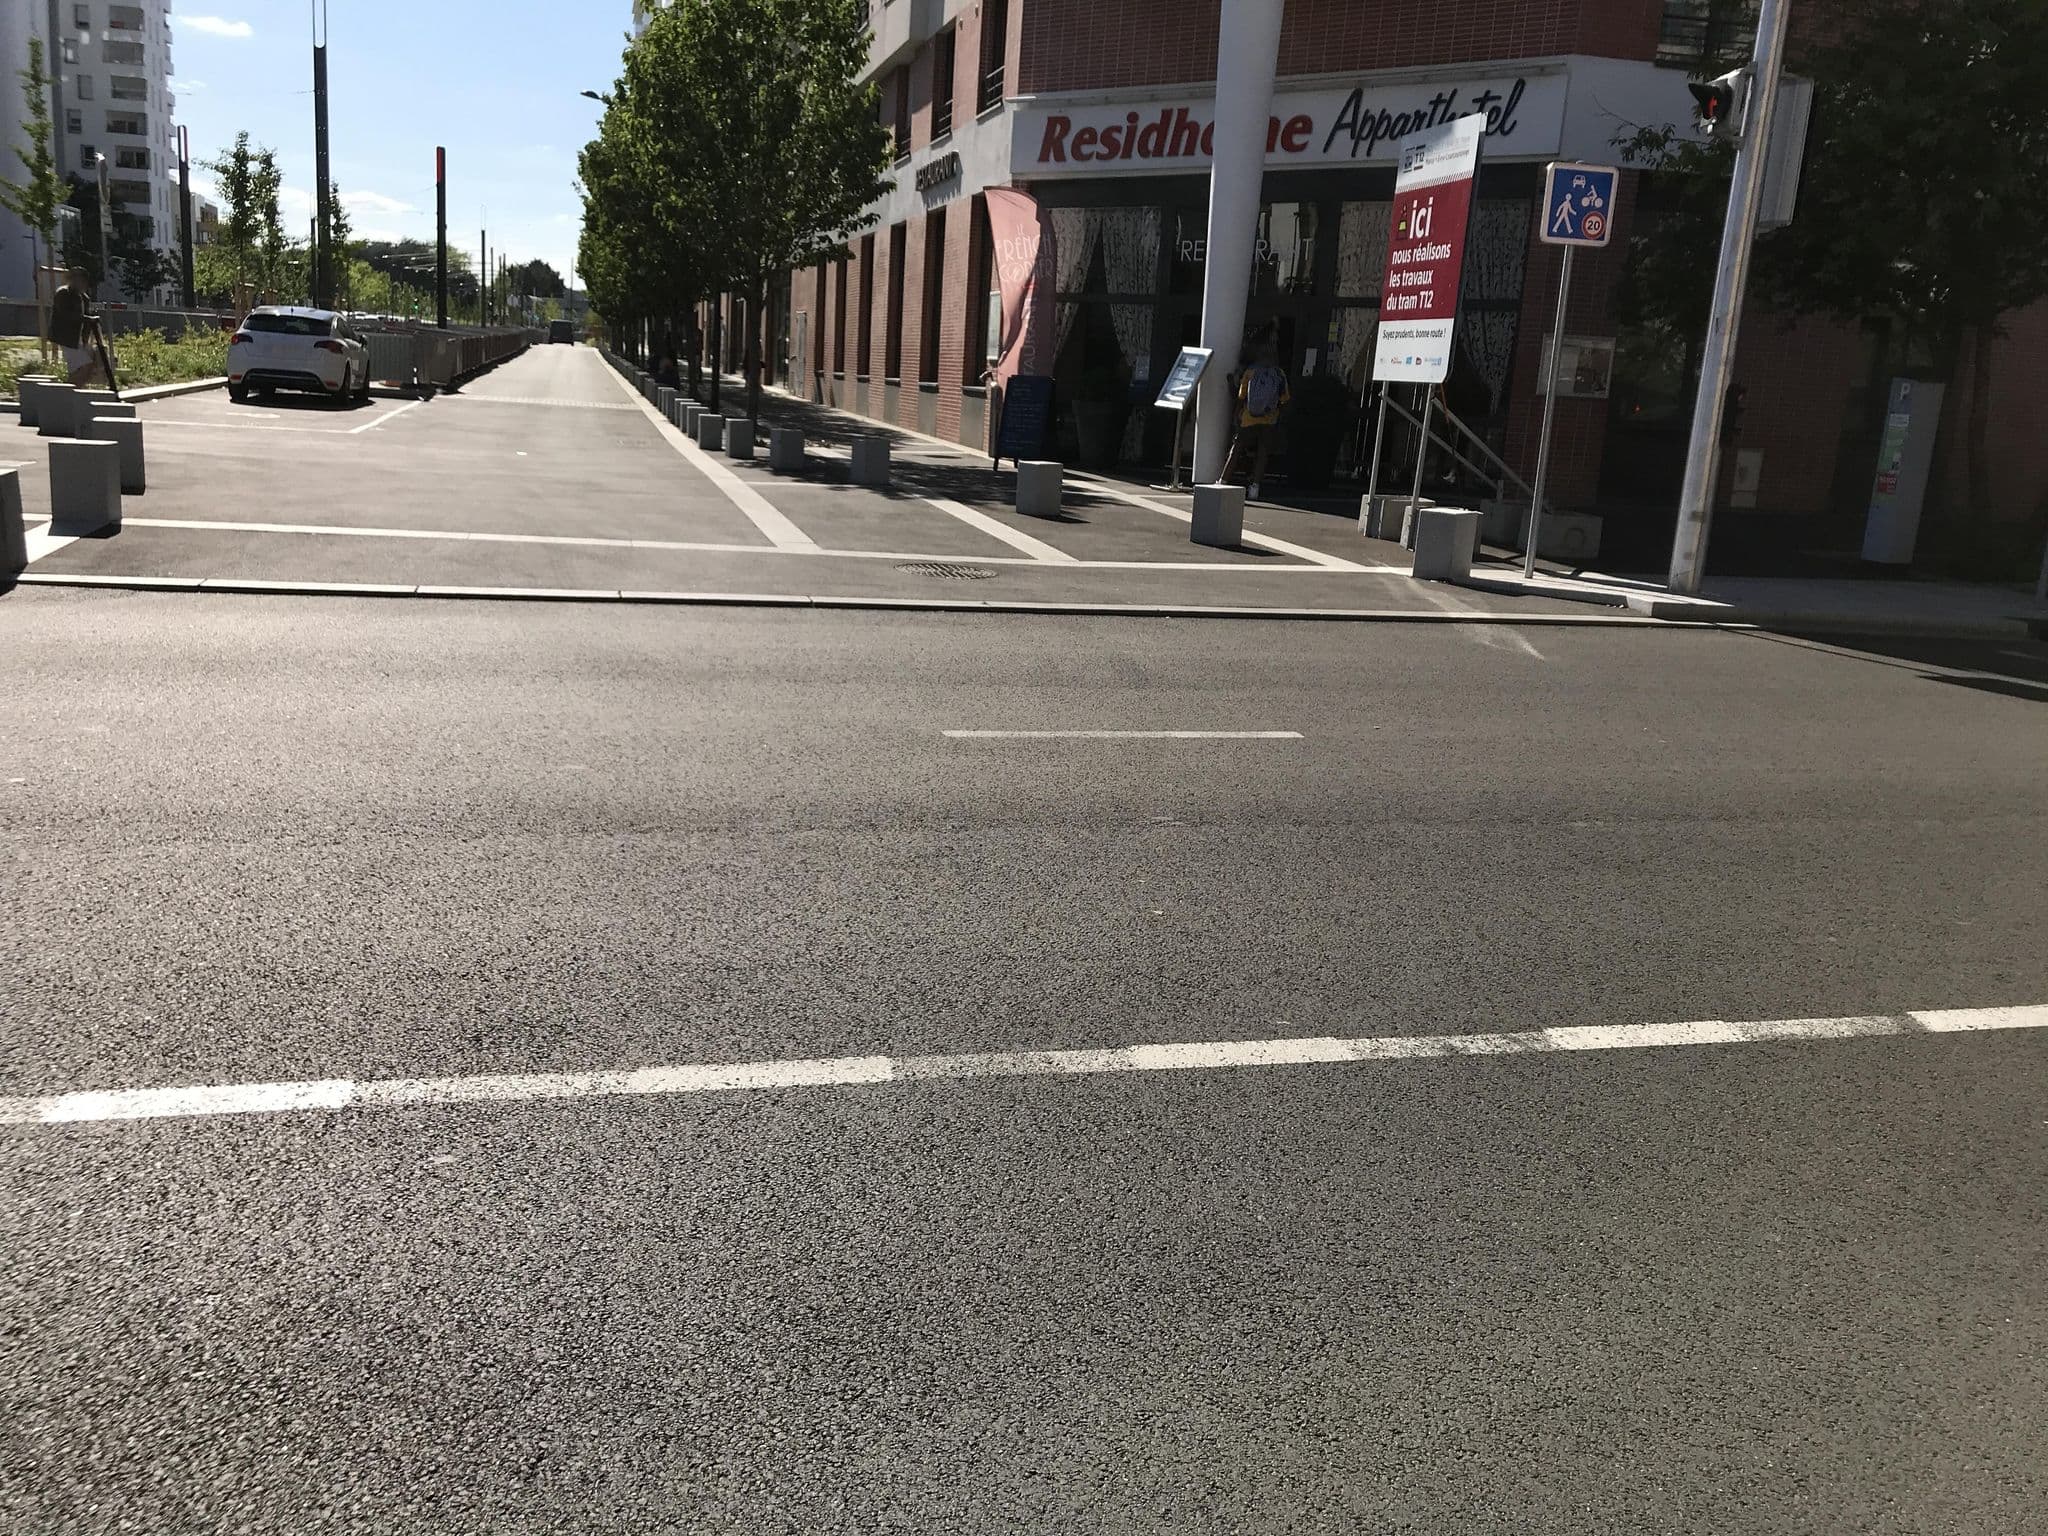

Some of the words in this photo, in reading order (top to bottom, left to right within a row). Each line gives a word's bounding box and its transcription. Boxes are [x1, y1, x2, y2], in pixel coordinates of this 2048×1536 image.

[1038, 107, 1313, 163] Residhe
[1323, 78, 1526, 158] Apparthtel
[1409, 196, 1434, 239] ici
[1587, 220, 1601, 231] 20
[1391, 248, 1411, 264] nous
[1412, 242, 1451, 262] réalisons
[1389, 270, 1400, 287] les
[1402, 269, 1433, 286] travaux
[1386, 293, 1397, 310] du
[1398, 293, 1417, 310] tram
[1420, 290, 1434, 309] T12
